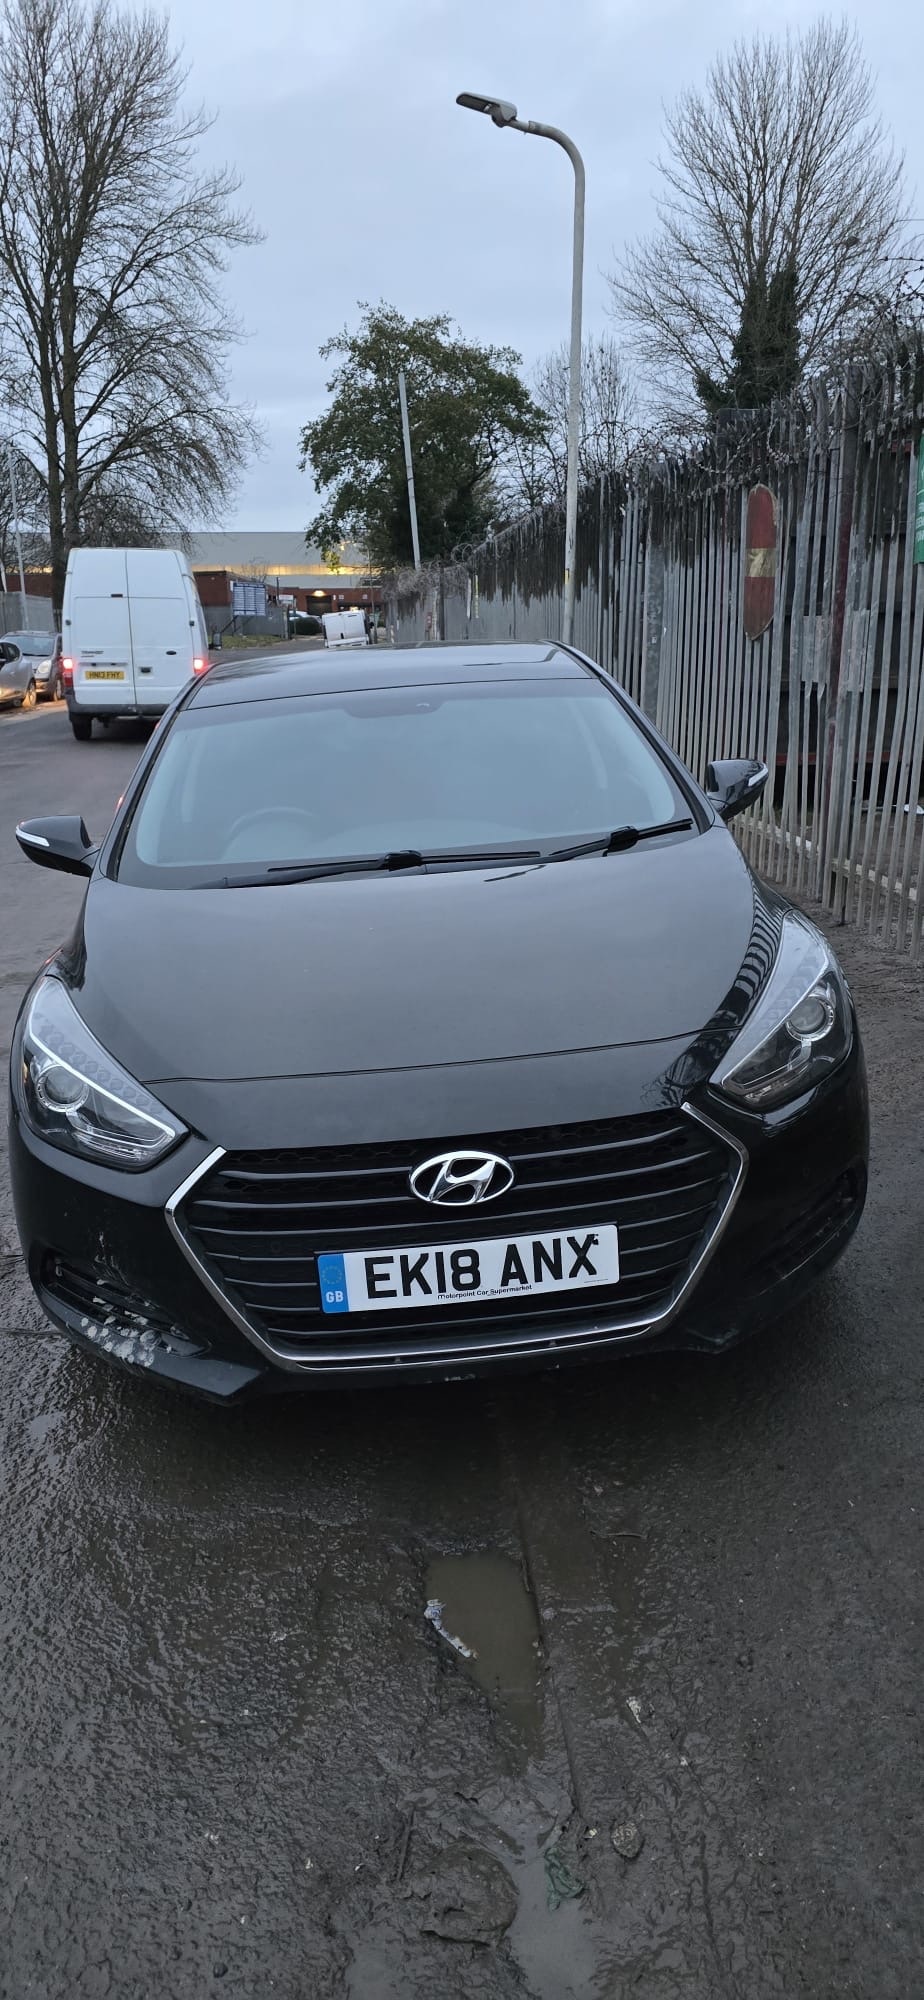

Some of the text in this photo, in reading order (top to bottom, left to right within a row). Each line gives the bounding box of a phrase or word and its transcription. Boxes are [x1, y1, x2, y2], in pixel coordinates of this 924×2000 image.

[364, 1233, 599, 1299] EK18 ANX
[325, 1291, 344, 1303] GB
